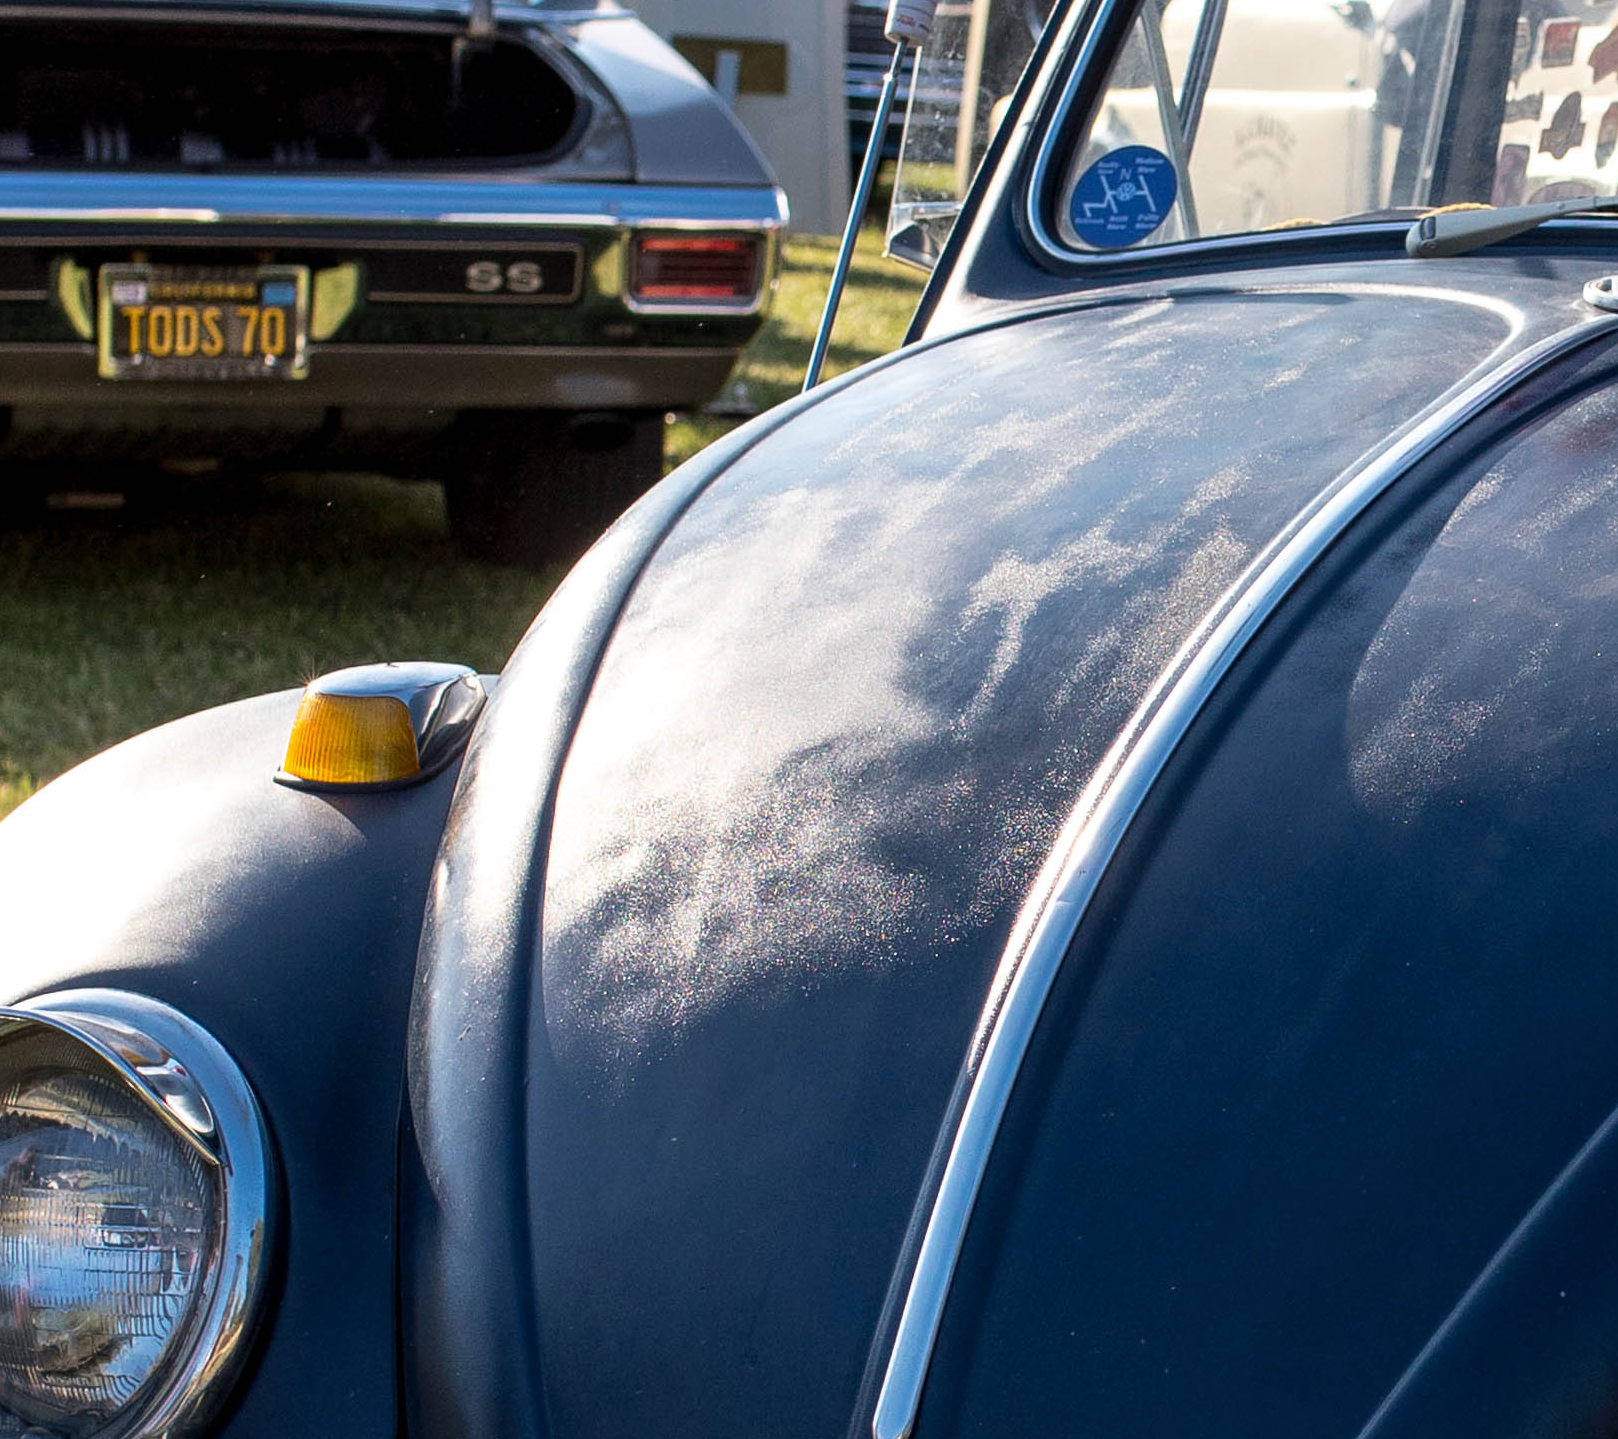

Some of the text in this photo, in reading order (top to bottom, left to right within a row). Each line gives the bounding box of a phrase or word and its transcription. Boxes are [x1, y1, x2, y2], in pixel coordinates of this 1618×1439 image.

[464, 261, 543, 293] SS
[121, 304, 287, 358] TODS 70
